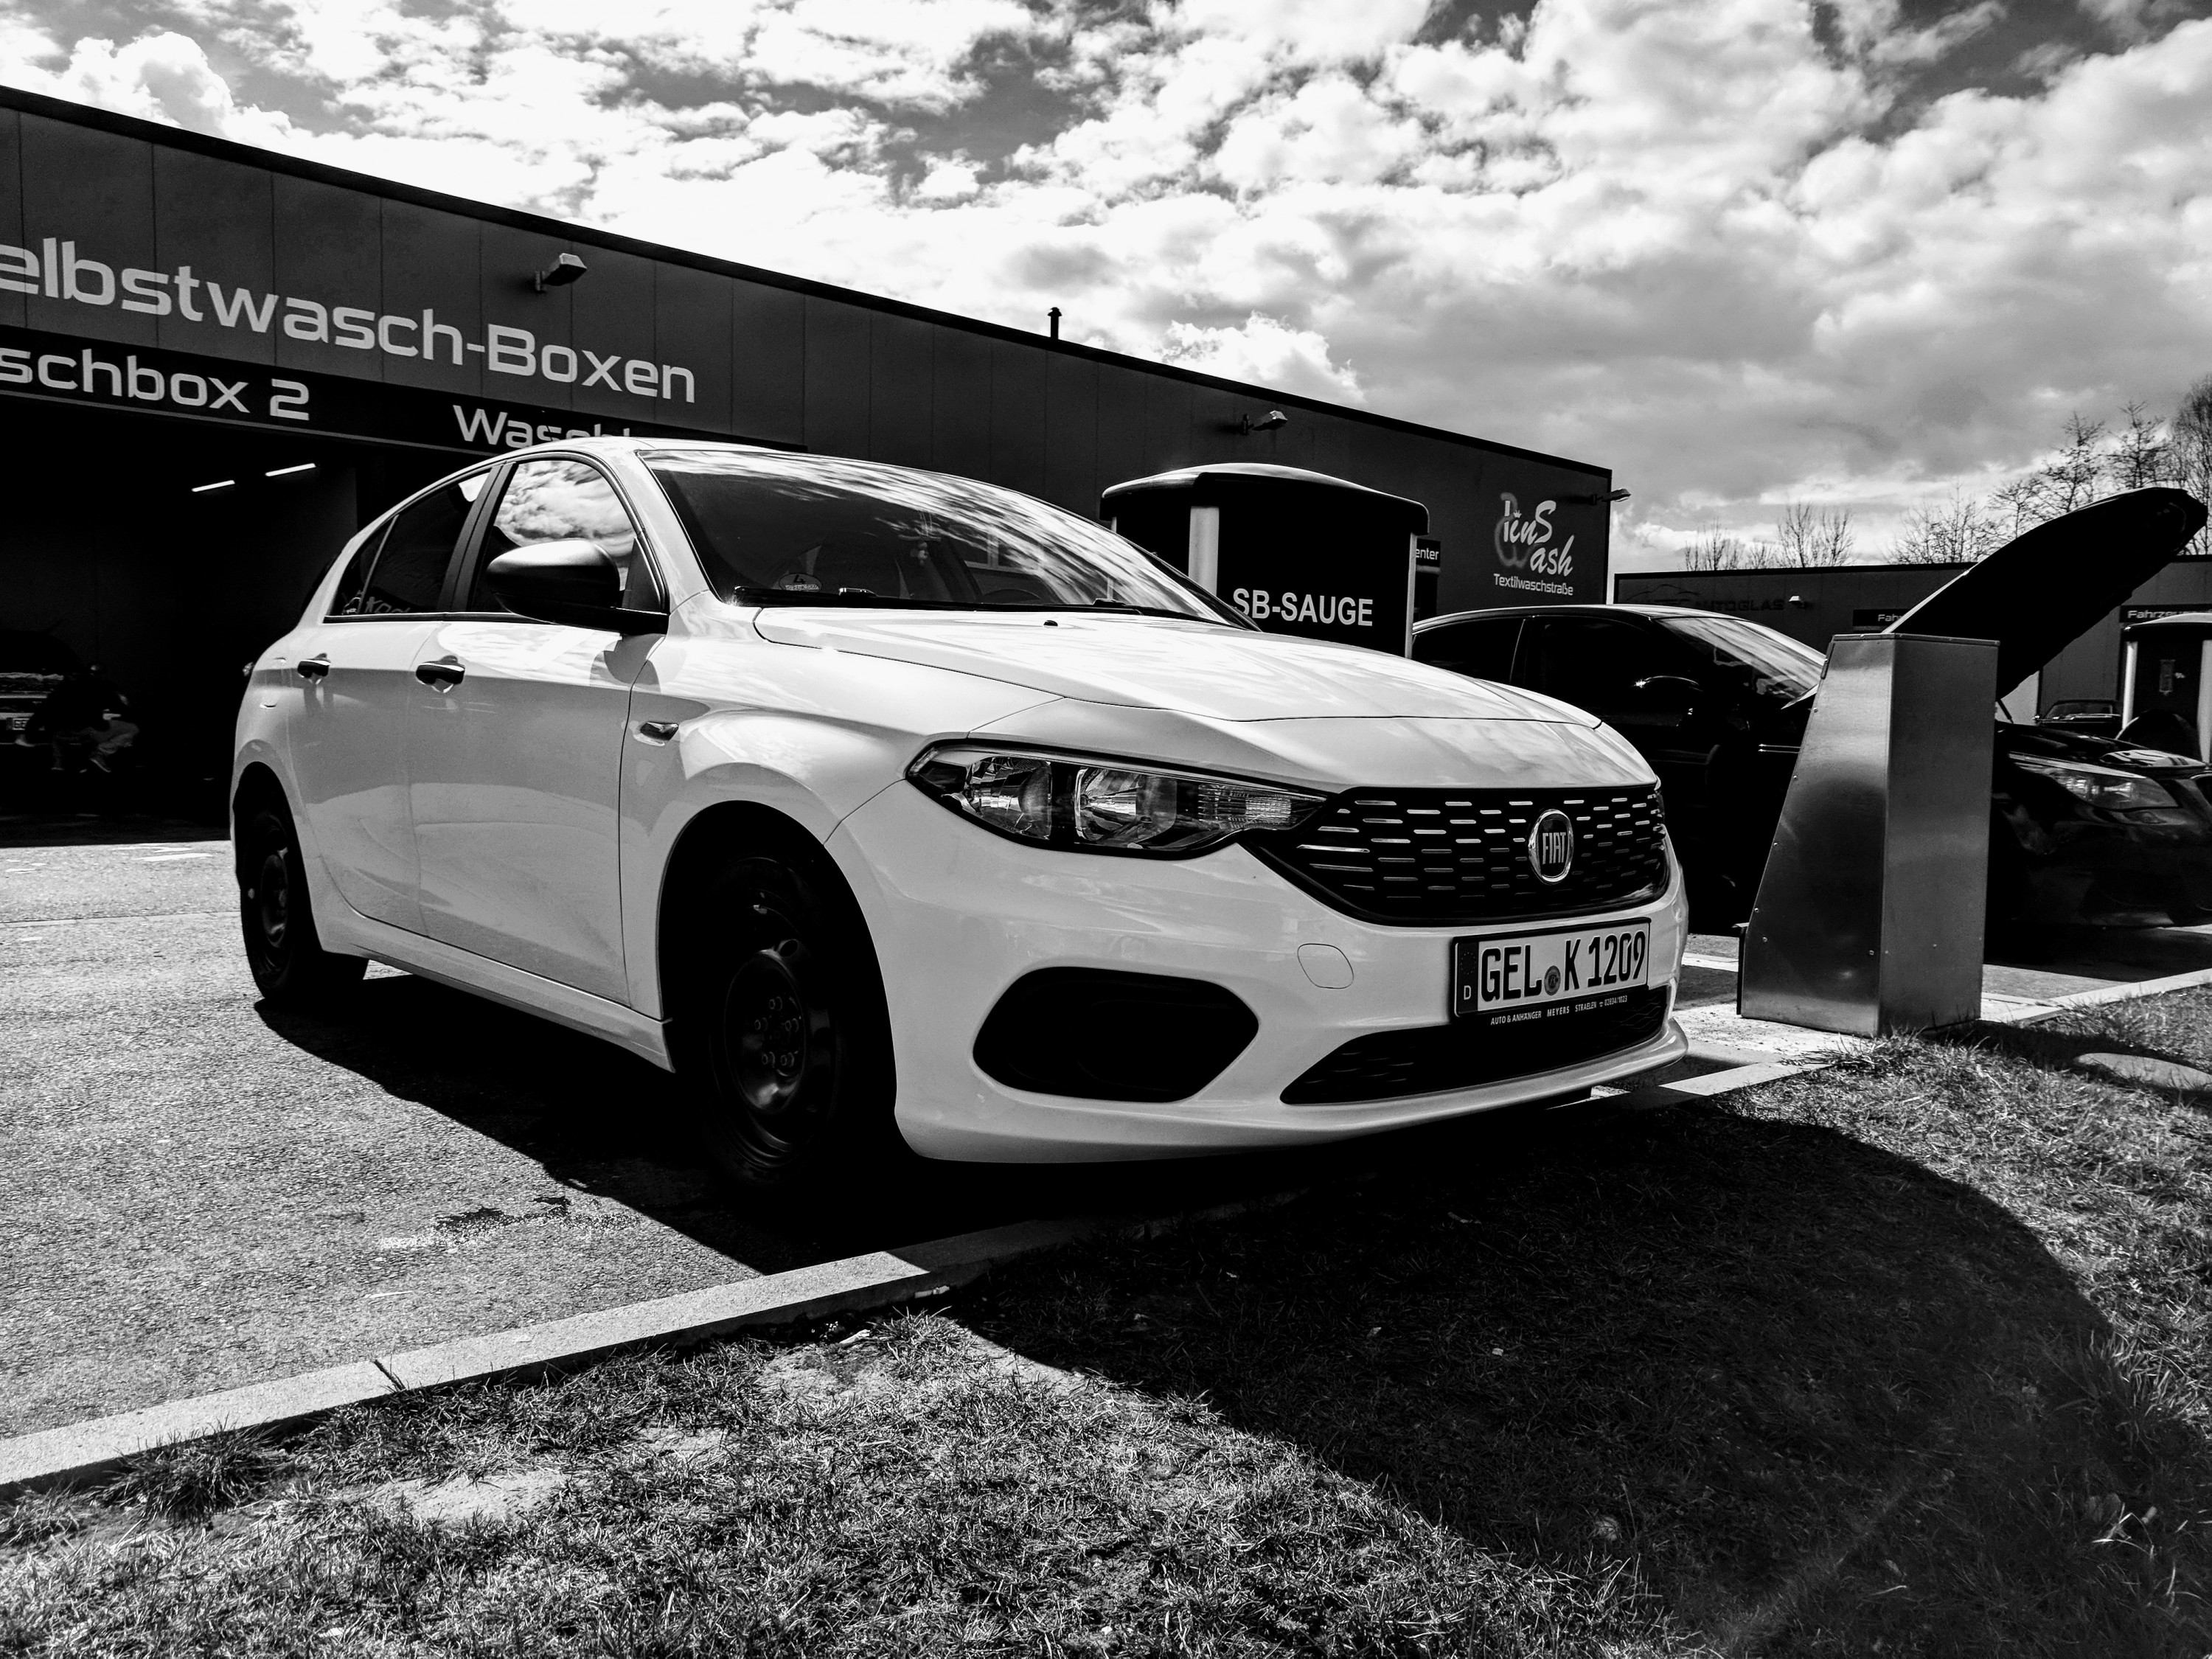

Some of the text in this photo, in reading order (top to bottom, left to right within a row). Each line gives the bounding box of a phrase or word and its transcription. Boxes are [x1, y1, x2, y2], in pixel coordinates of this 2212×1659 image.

[0, 347, 310, 422] schbox 2
[1493, 572, 1574, 597] Textilwaschstraße
[1233, 588, 1374, 627] SB-SAUGE
[1542, 832, 1567, 865] FIAT
[1480, 930, 1646, 1002] GEL K 1209
[1463, 984, 1472, 1001] D
[1490, 1015, 1506, 1026] AUTO
[1506, 1015, 1512, 1023] &
[1546, 1006, 1570, 1018] MEYERS
[1574, 1001, 1597, 1012] STRAELEN
